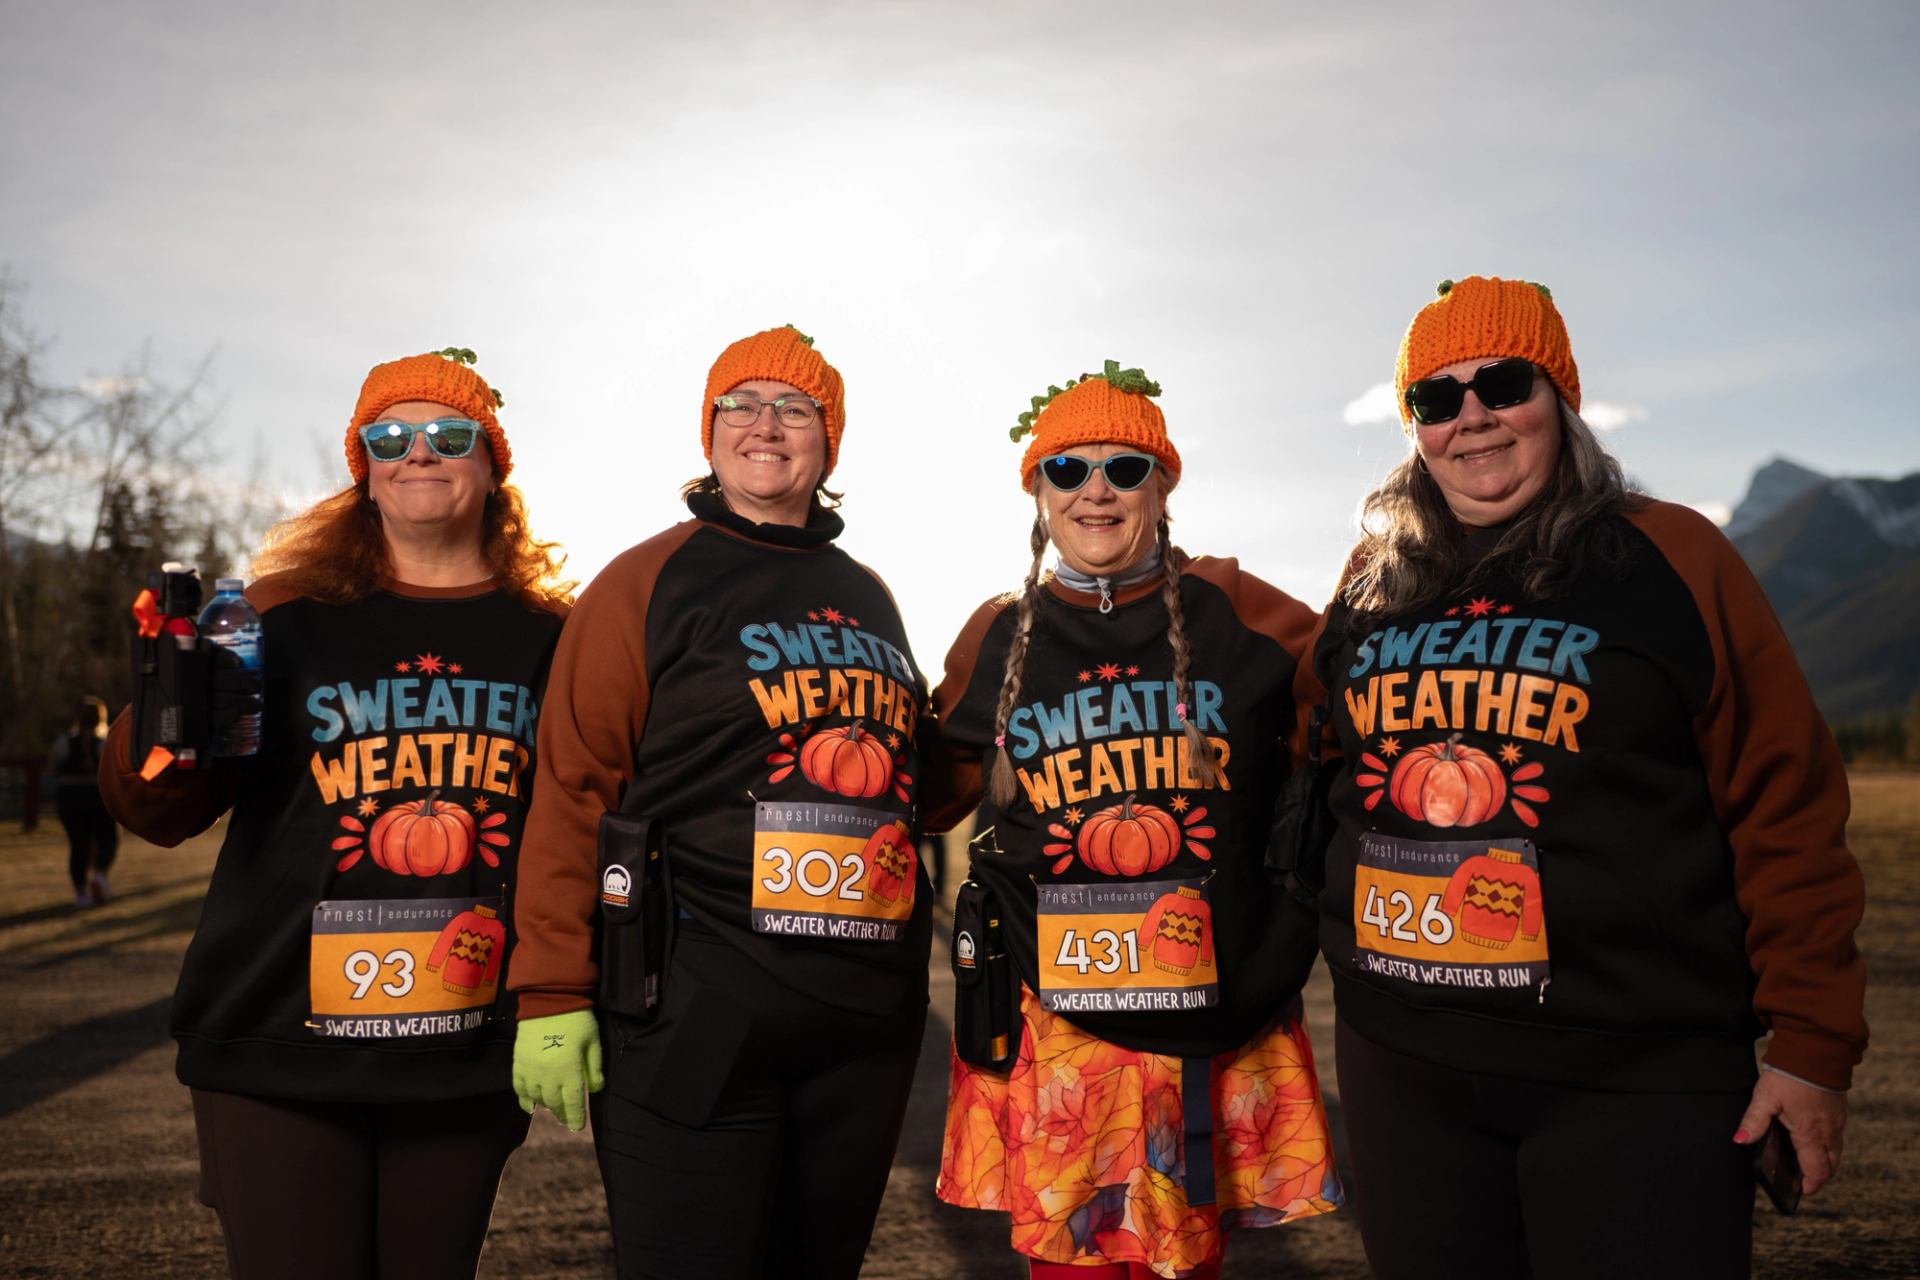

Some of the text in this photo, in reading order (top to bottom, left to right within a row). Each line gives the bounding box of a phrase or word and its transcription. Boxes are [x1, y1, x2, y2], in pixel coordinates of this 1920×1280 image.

[1349, 618, 1599, 684] SWEATER
[306, 678, 537, 747] SWEATER
[1008, 680, 1229, 760] SWEATER
[1345, 670, 1589, 752] WEATHER
[310, 733, 529, 805] WEATHER
[1016, 736, 1232, 814] WEATHER
[824, 814, 879, 828] endurance
[761, 847, 866, 901] 302
[1400, 848, 1460, 864] endurance
[388, 908, 453, 920] endurance
[1097, 891, 1155, 902] endurance
[1361, 884, 1455, 945] 426
[765, 914, 898, 941] SWEATER WEATHER RUN
[1054, 929, 1141, 975] 431
[343, 948, 416, 1001] 93
[1367, 953, 1531, 988] SWEATER WEATHER RUN
[325, 1011, 484, 1038] SWEATER WEATHER RUN
[1053, 990, 1207, 1011] SWEATER WEATHER RUN
